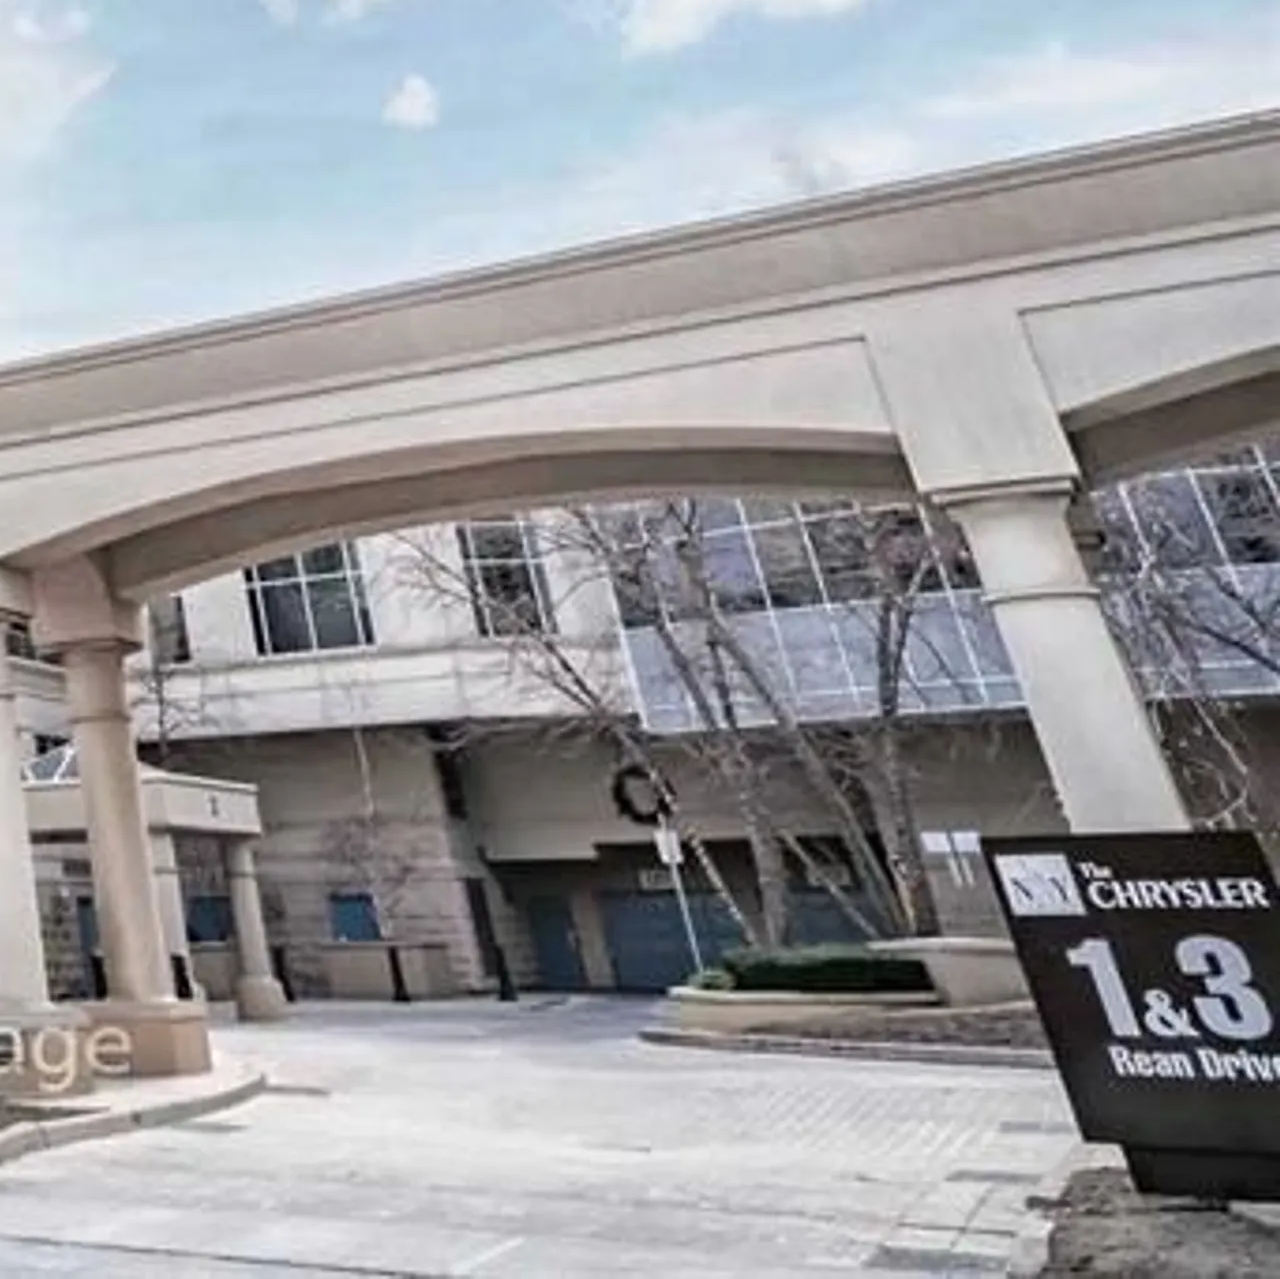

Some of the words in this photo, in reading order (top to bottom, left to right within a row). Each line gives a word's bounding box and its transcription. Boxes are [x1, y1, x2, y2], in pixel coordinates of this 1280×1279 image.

[1077, 862, 1113, 878] The
[1088, 878, 1270, 909] CHRYSLER
[1107, 1045, 1195, 1079] Rean
